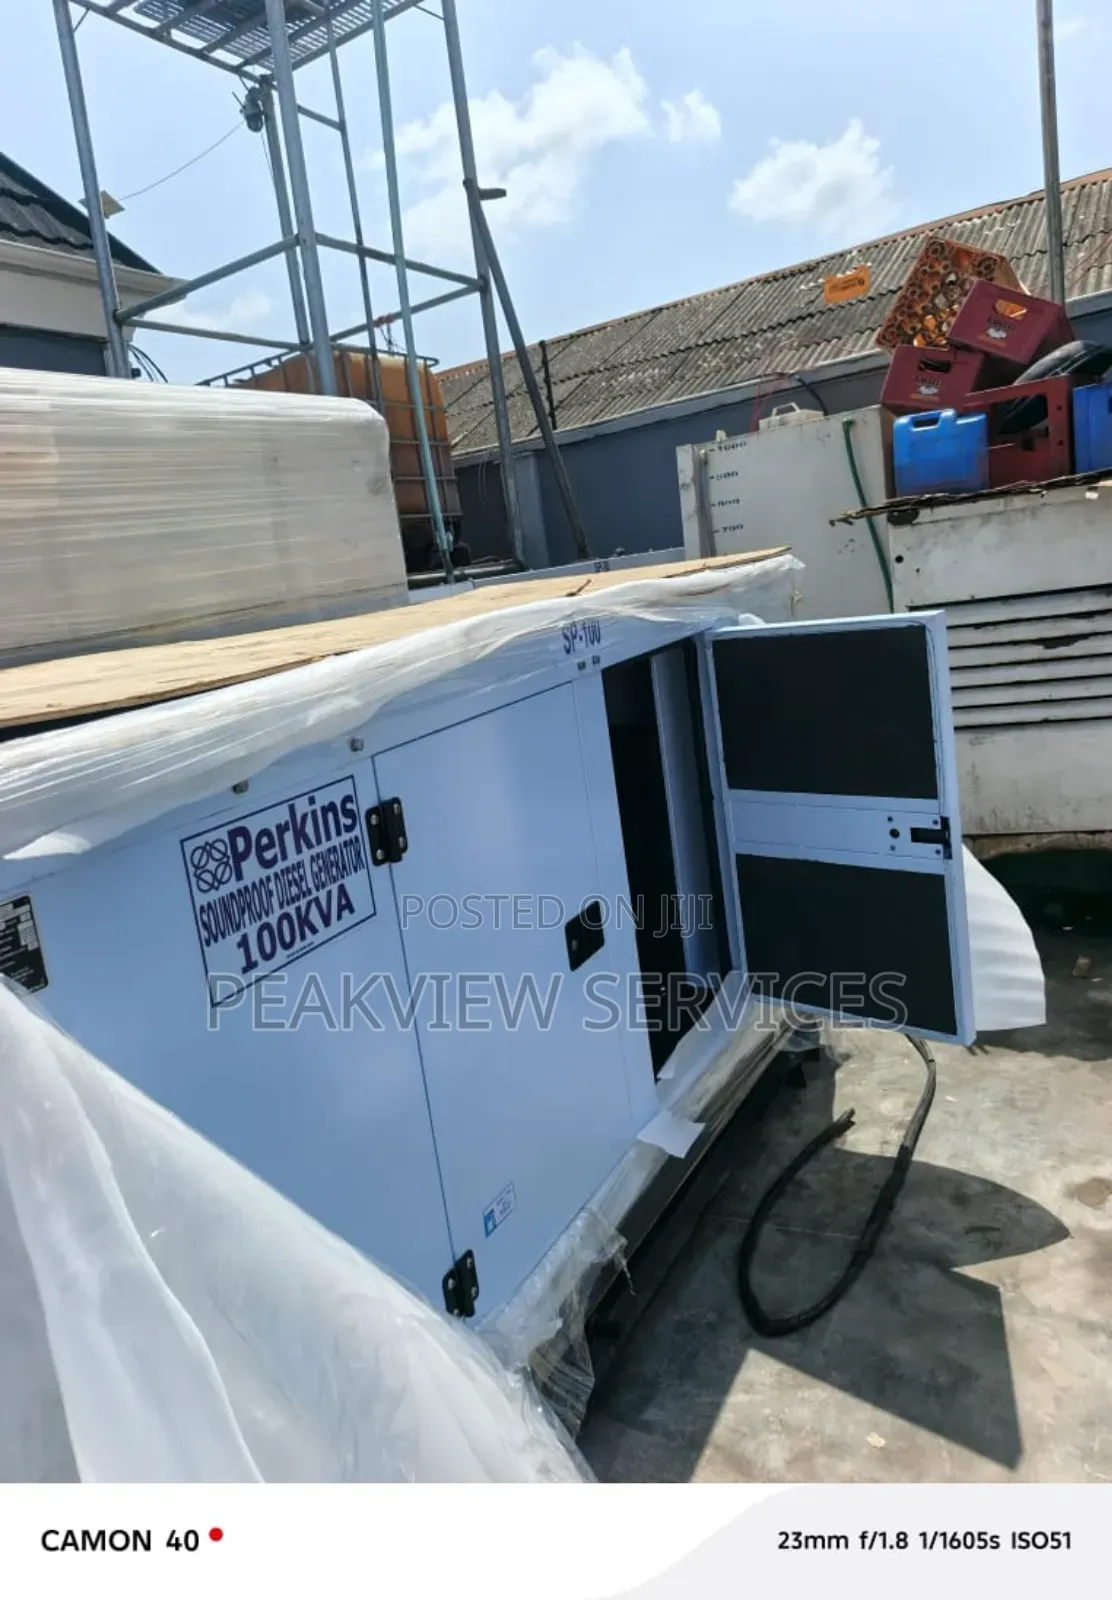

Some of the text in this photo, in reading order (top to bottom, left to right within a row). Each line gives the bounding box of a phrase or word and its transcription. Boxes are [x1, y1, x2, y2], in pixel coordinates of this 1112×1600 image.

[227, 794, 358, 882] Perkins
[200, 835, 366, 947] SOUNDPROOF DIESEL GENERATOR
[236, 883, 355, 974] 100KVA
